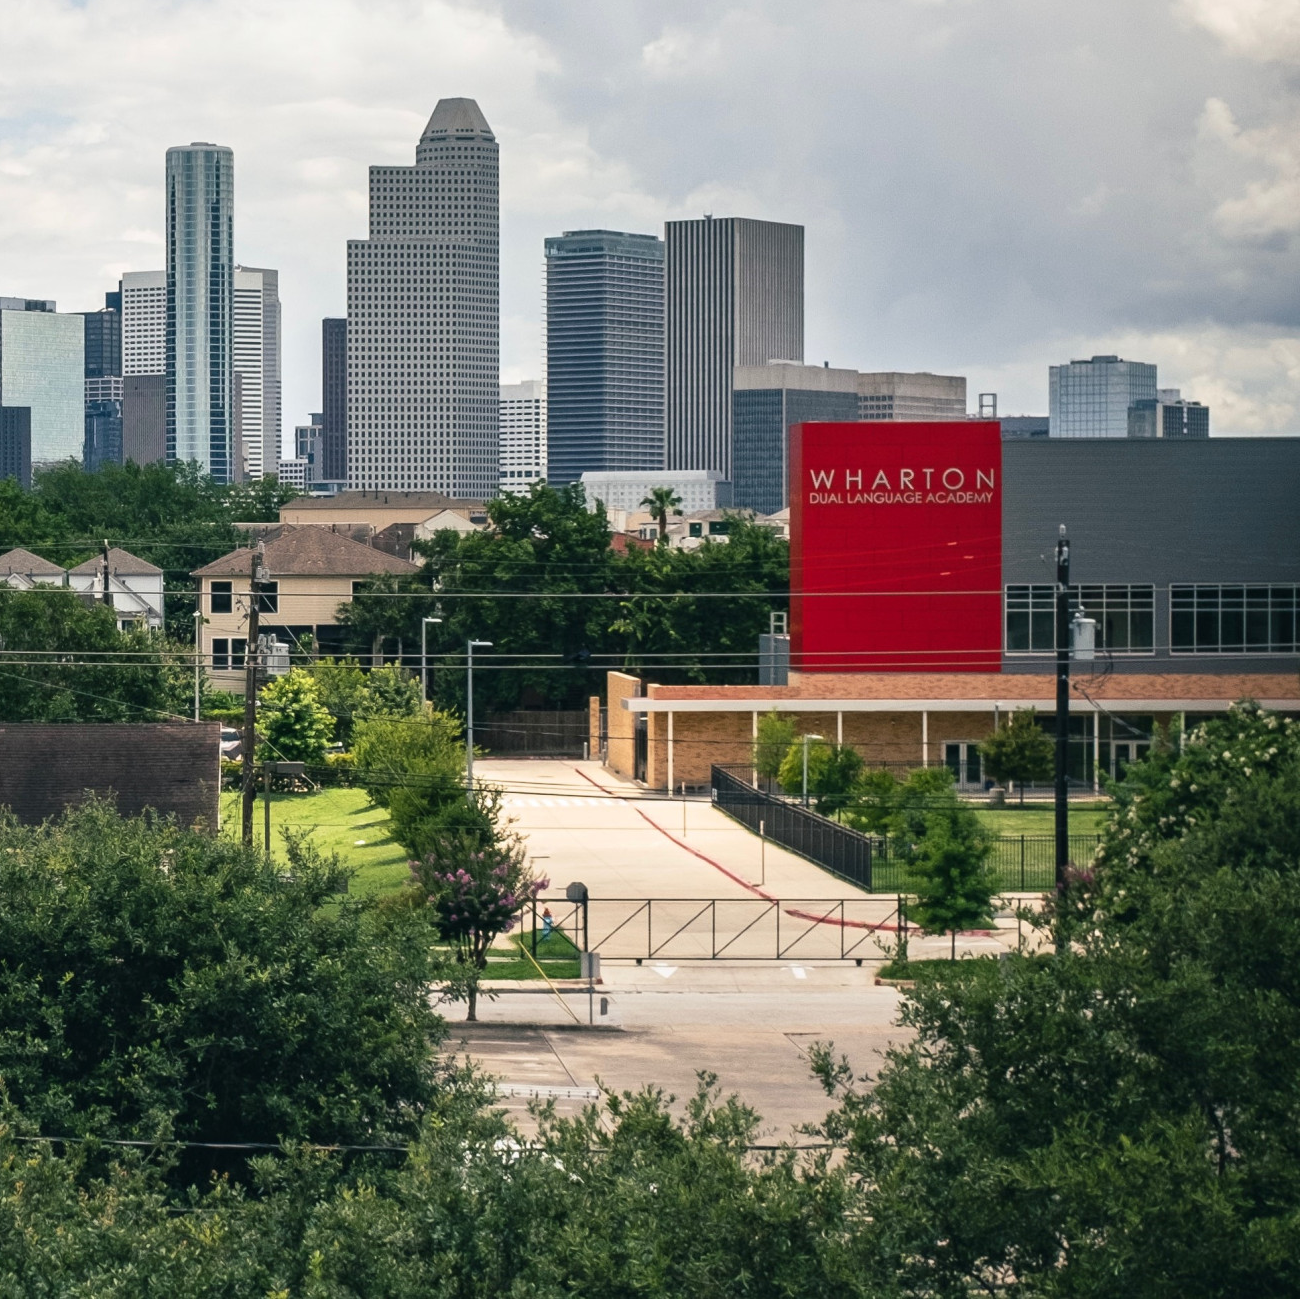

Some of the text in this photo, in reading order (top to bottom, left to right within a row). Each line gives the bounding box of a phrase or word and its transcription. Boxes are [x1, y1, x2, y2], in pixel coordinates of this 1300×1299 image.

[810, 468, 995, 490] WHARTON
[809, 492, 994, 504] DUAL LANGUAGE ACADEMY
